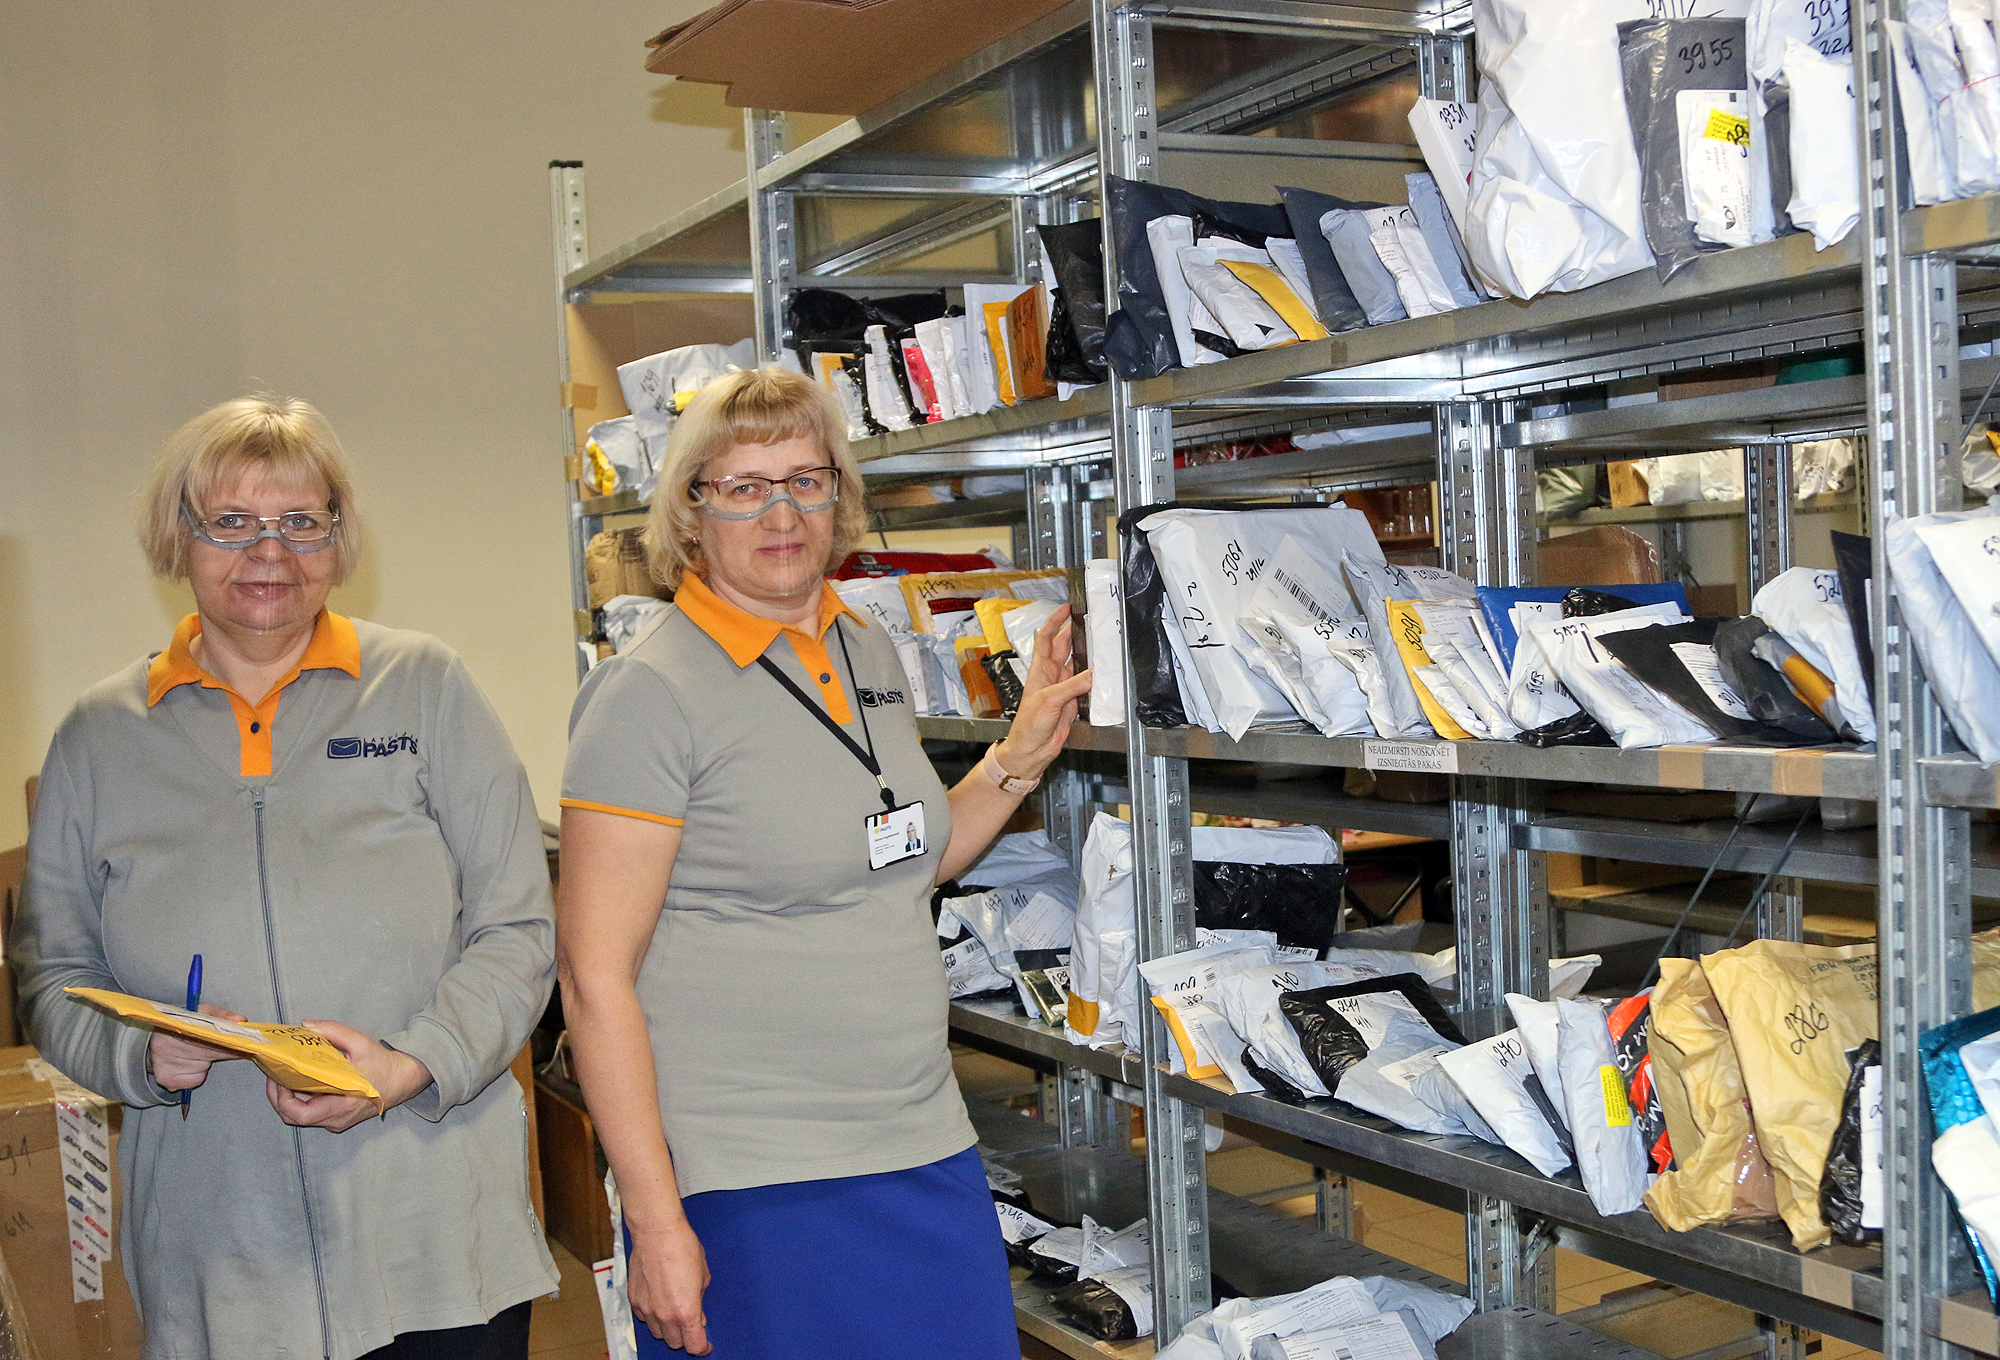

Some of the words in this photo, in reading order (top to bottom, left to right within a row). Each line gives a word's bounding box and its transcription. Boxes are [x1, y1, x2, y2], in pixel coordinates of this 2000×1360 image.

[1679, 37, 1735, 74] 3955
[1368, 745, 1410, 756] NEAIZMIRSTI
[1377, 758, 1417, 768] IZSNIEGTĀS
[1418, 760, 1442, 769] PAKAS
